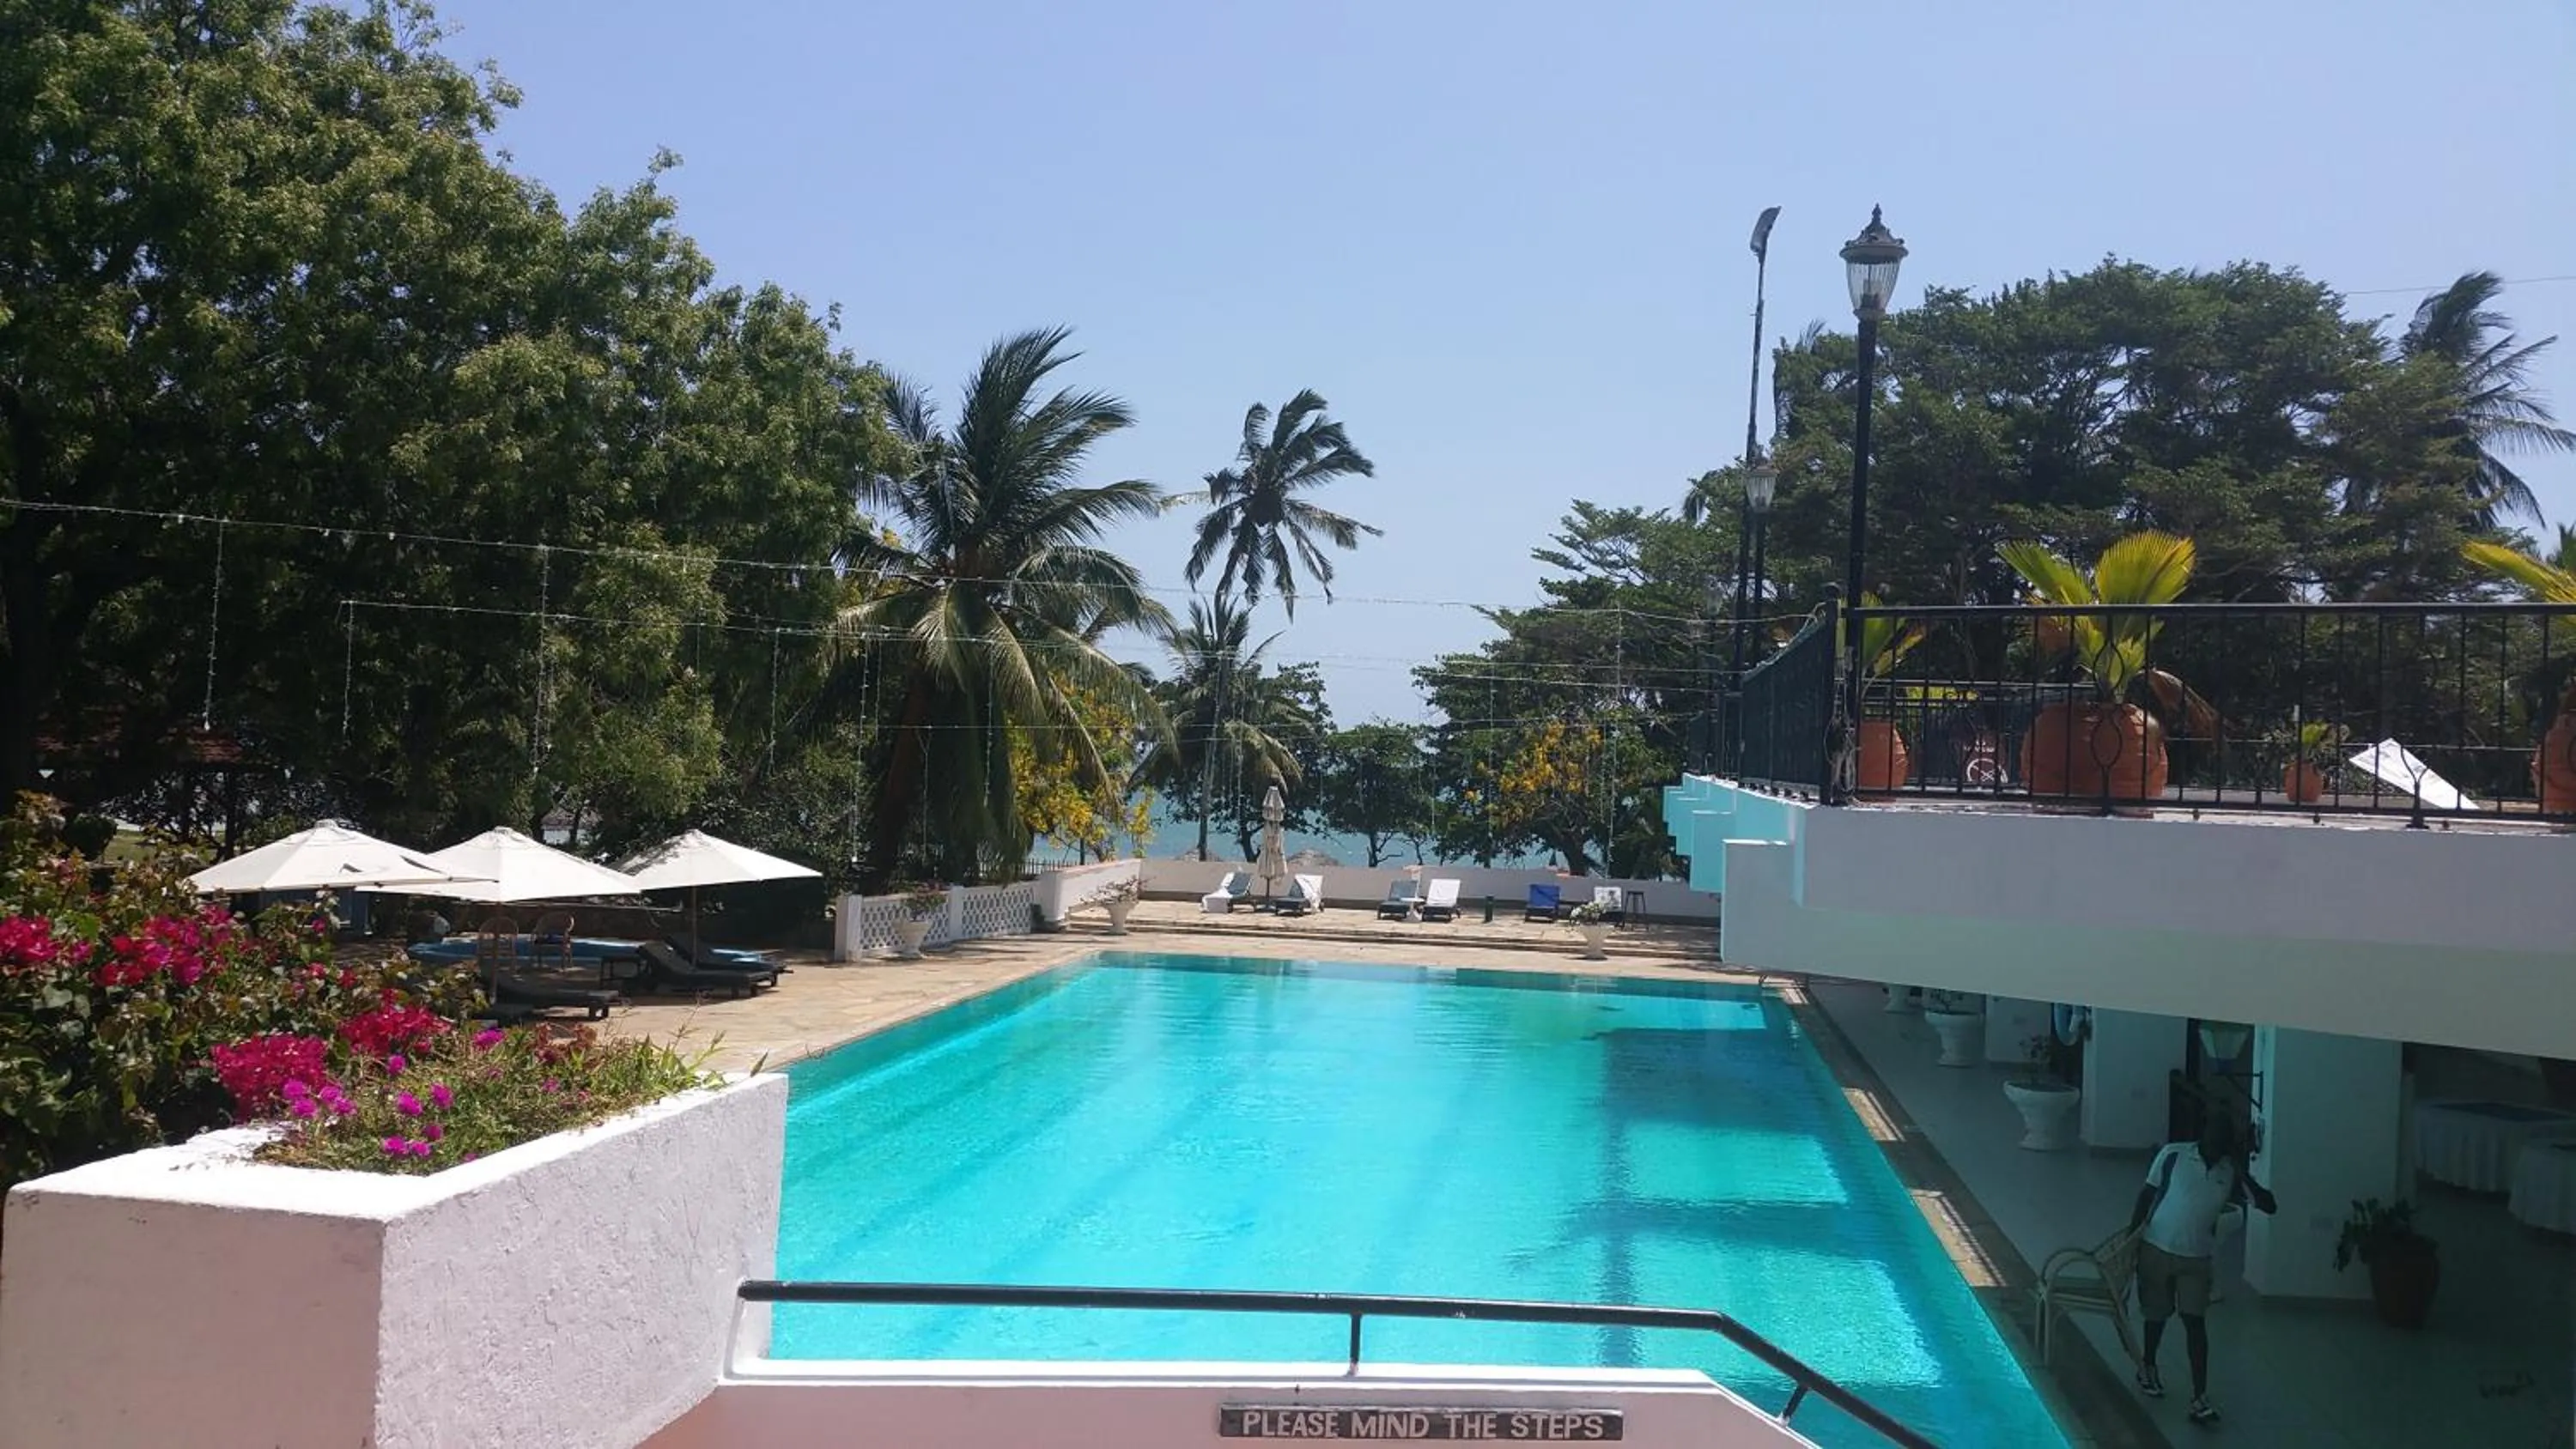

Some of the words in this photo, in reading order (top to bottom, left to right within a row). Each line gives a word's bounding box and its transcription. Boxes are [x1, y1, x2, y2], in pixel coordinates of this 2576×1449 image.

[1242, 1411, 1339, 1437] PLEASE
[1351, 1412, 1430, 1438] MIND
[1443, 1414, 1497, 1438] THE
[1510, 1414, 1604, 1439] STEPS
